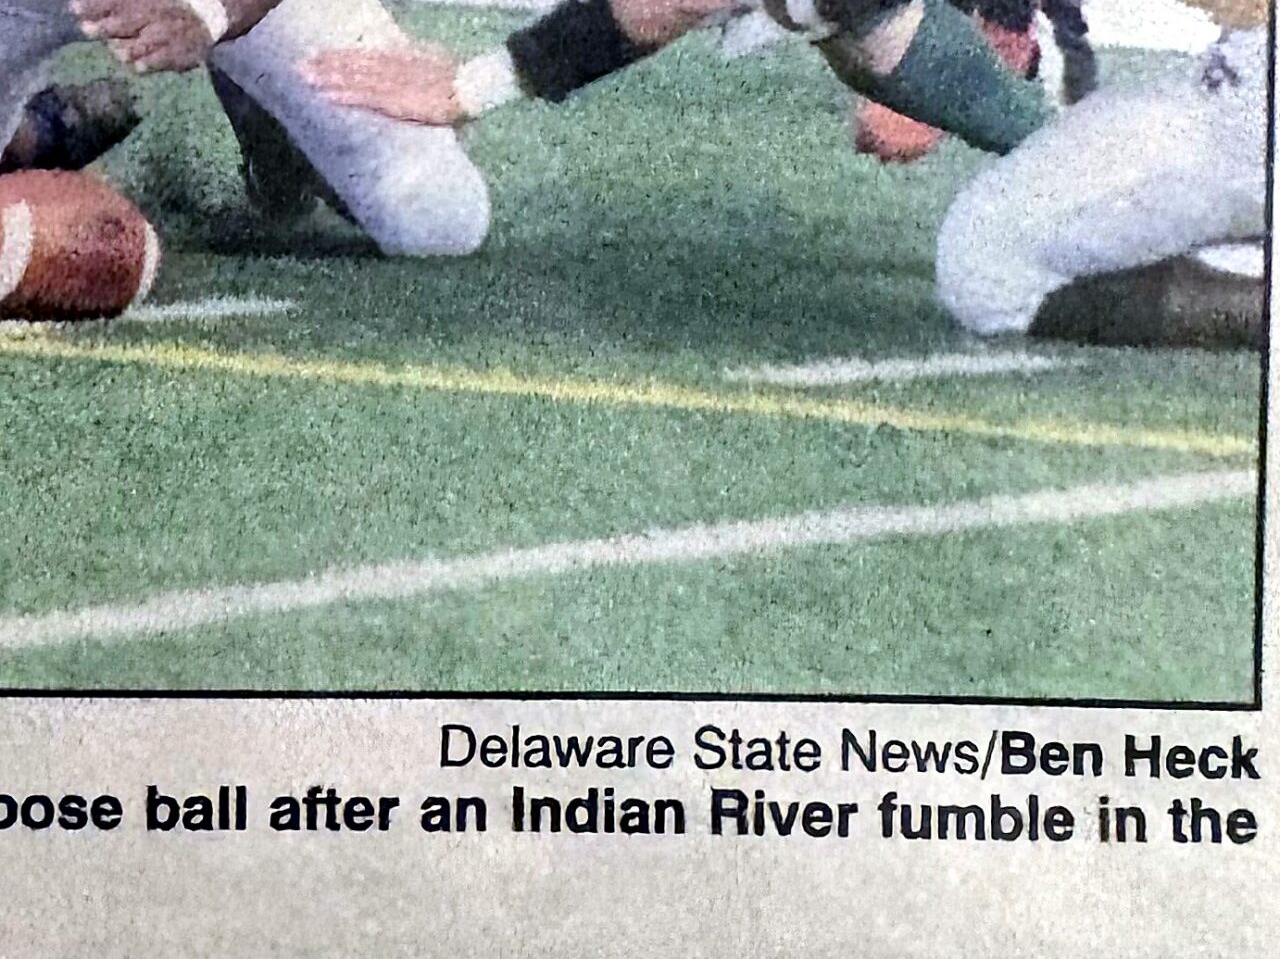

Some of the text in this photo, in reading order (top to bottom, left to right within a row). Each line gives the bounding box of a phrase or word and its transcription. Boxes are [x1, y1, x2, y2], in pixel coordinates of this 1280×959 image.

[440, 724, 1261, 781] Delaware State News/Ben Heck
[145, 784, 247, 832] ball
[269, 785, 400, 832] after
[420, 796, 487, 833] an
[512, 785, 686, 836] Indian
[710, 786, 859, 838] River
[877, 791, 1075, 842] fumble
[1098, 796, 1148, 843] in
[1167, 797, 1258, 845] the
